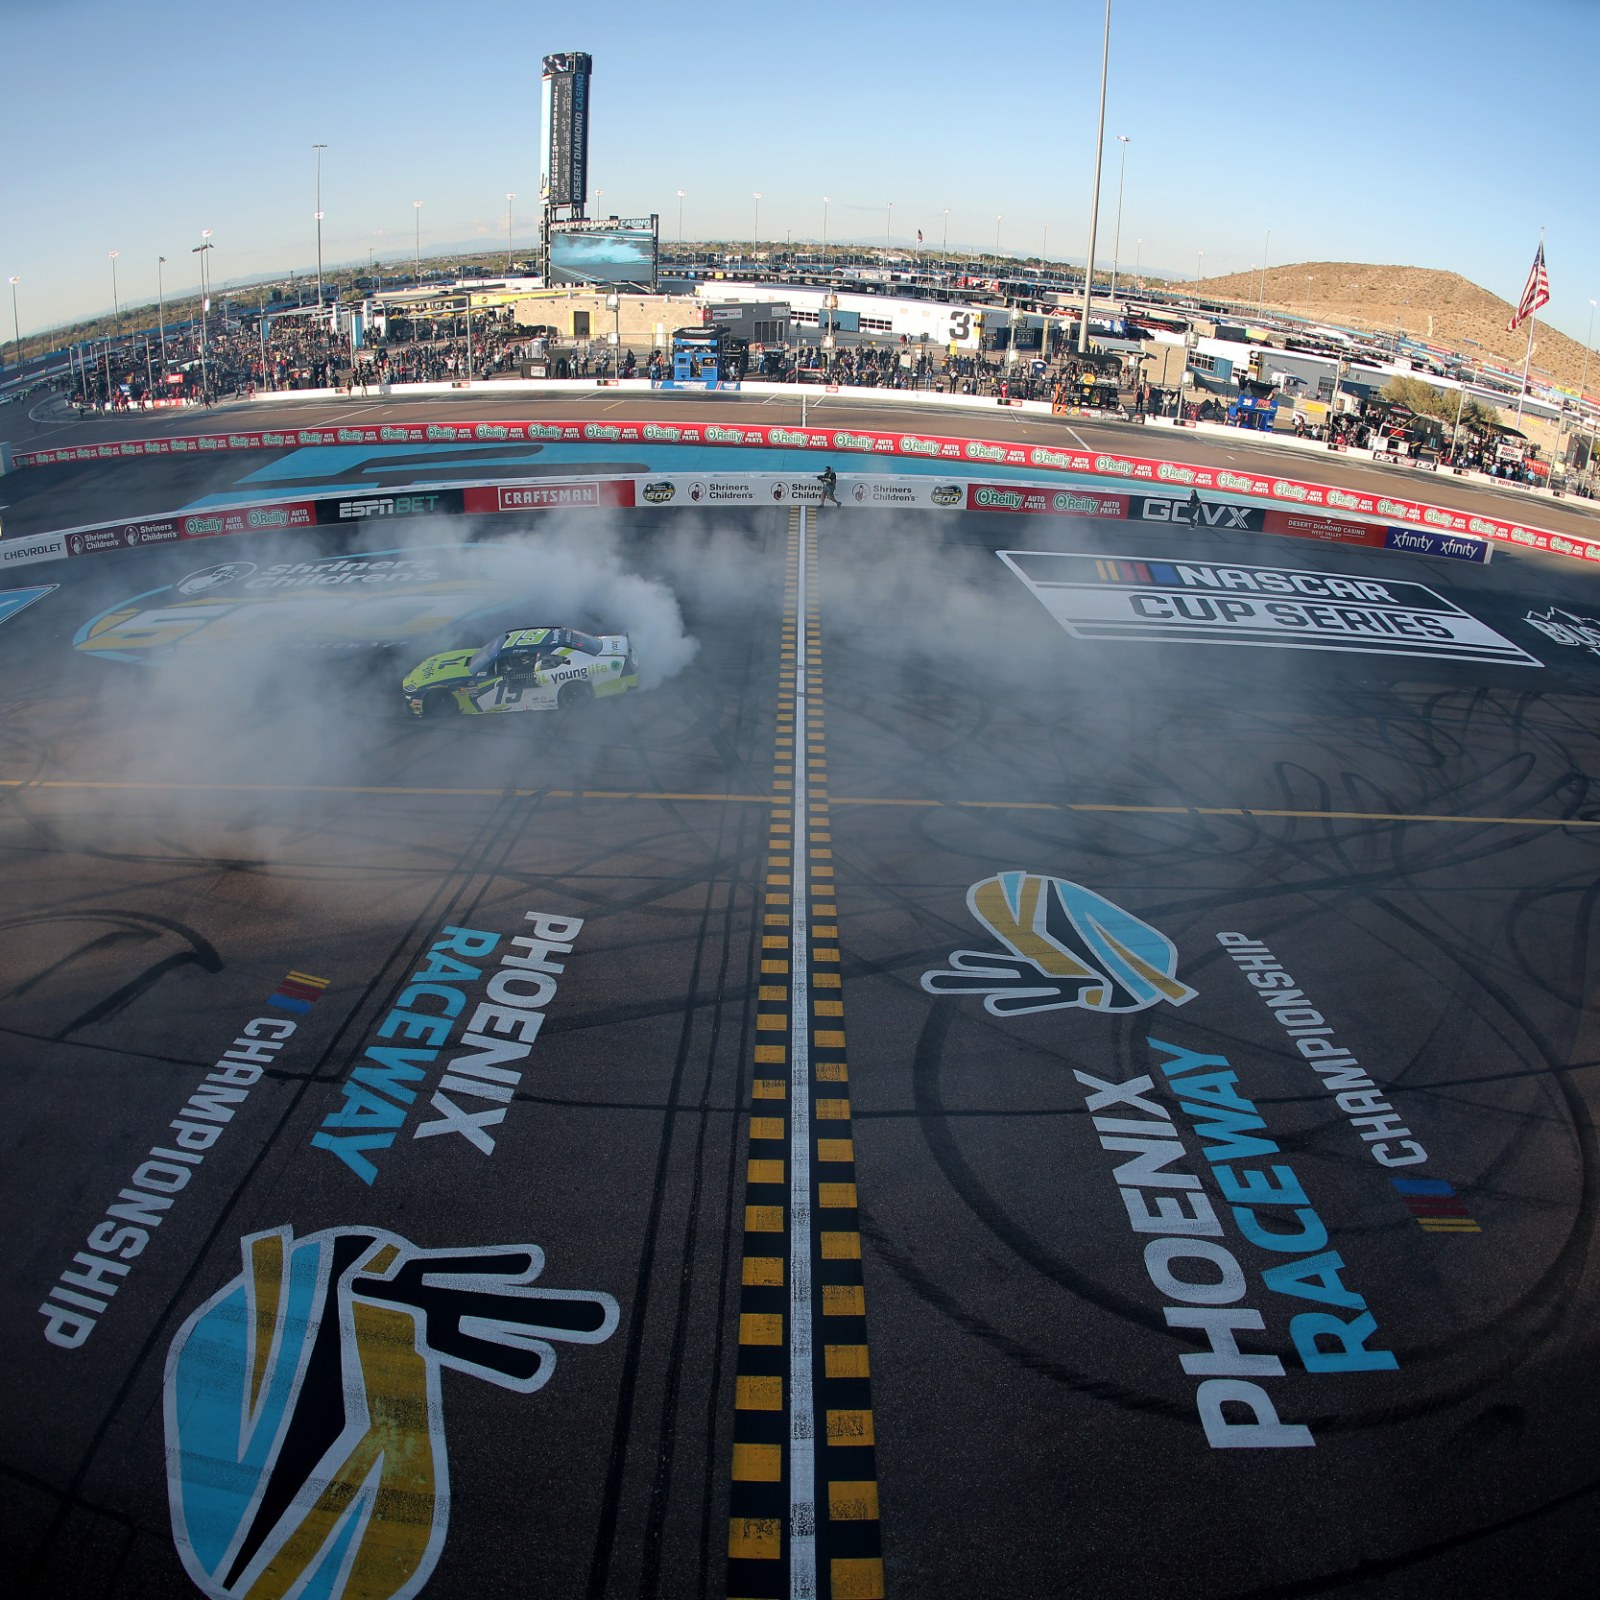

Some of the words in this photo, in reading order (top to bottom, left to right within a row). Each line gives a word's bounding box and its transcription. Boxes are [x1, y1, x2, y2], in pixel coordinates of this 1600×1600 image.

[575, 74, 584, 110] CASINO
[574, 112, 584, 160] DIAMOND
[574, 162, 582, 200] DESERT
[551, 222, 580, 230] DESERT
[582, 220, 618, 228] DIAMOND
[620, 219, 650, 227] CASINO
[950, 311, 970, 340] 3
[426, 424, 456, 440] O'Reilly
[476, 424, 508, 440] O'Reilly
[529, 423, 562, 440] O'Reilly
[585, 423, 620, 440] O'Reilly
[643, 425, 681, 441] O'Reilly
[705, 426, 743, 444] O'Reilly
[769, 429, 808, 446] O'Reilly
[833, 432, 874, 451] O'Reilly
[900, 437, 941, 456] O'Reilly
[966, 442, 1007, 462] O'Reilly
[1031, 448, 1071, 468] O'Reilly
[1375, 452, 1395, 463] DEX
[1095, 456, 1134, 476] O'Reilly
[1158, 464, 1196, 483] O'Reilly
[1416, 461, 1434, 470] DEX
[873, 485, 912, 494] Shriners
[1217, 472, 1253, 492] O'Reilly
[505, 489, 592, 504] CRAFTSMAN
[646, 492, 672, 500] 500
[873, 493, 916, 502] Children's
[975, 487, 1024, 510] O'Reilly
[1053, 493, 1099, 515] O'Reilly
[340, 499, 394, 518] ESPN
[396, 496, 439, 513] BET
[186, 517, 223, 534] O'Reilly
[248, 509, 288, 528] O'Reilly
[1288, 520, 1312, 528] DESERT
[1314, 524, 1342, 532] DIAMOND
[84, 532, 114, 542] Shriners
[140, 523, 172, 534] Shriners
[142, 531, 178, 541] Children's
[4, 543, 61, 560] CHEVROLET
[86, 538, 119, 550] Children's
[1393, 532, 1434, 551] xfinity
[1440, 539, 1478, 558] xfinity
[261, 559, 437, 576] Shriners
[245, 570, 441, 589] Children's
[1176, 566, 1400, 604] NASCAR
[1129, 594, 1255, 622] CUP
[1265, 603, 1454, 639] SERIES
[502, 628, 551, 649] 19
[413, 911, 584, 1155] PHOENIX
[310, 927, 501, 1185] RACEWAY
[1216, 931, 1429, 1168] CHAMPIONSHIP
[38, 1017, 297, 1349] CHAMPIONSHIP
[1147, 1036, 1400, 1373] RACEWAY
[1073, 1069, 1316, 1448] PHOENIX
